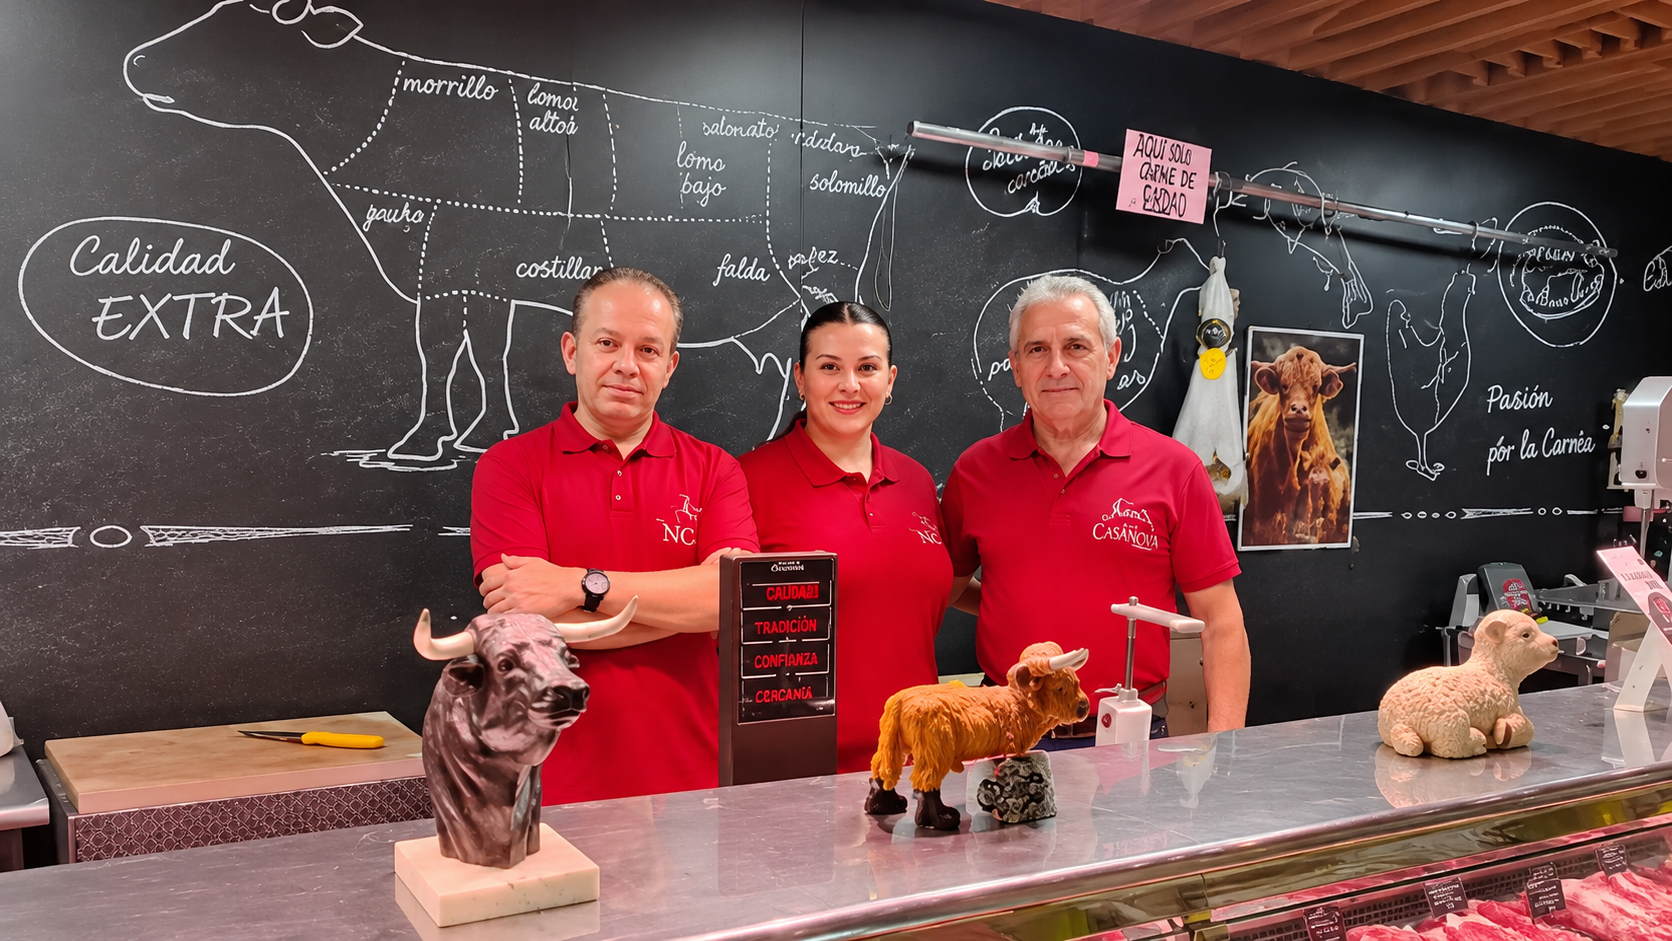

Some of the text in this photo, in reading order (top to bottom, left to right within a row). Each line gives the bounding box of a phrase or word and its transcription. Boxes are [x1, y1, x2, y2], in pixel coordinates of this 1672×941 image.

[402, 74, 499, 102] morrillo
[677, 141, 726, 171] lomo
[680, 173, 726, 207] bajo
[809, 170, 886, 198] solomillo
[1180, 170, 1197, 190] DE
[69, 235, 236, 276] Calidad
[712, 253, 770, 286] falda
[91, 286, 290, 341] EXTRA
[1487, 384, 1553, 413] Pasión
[1520, 428, 1538, 460] la
[754, 652, 818, 669] CONFIANZA
